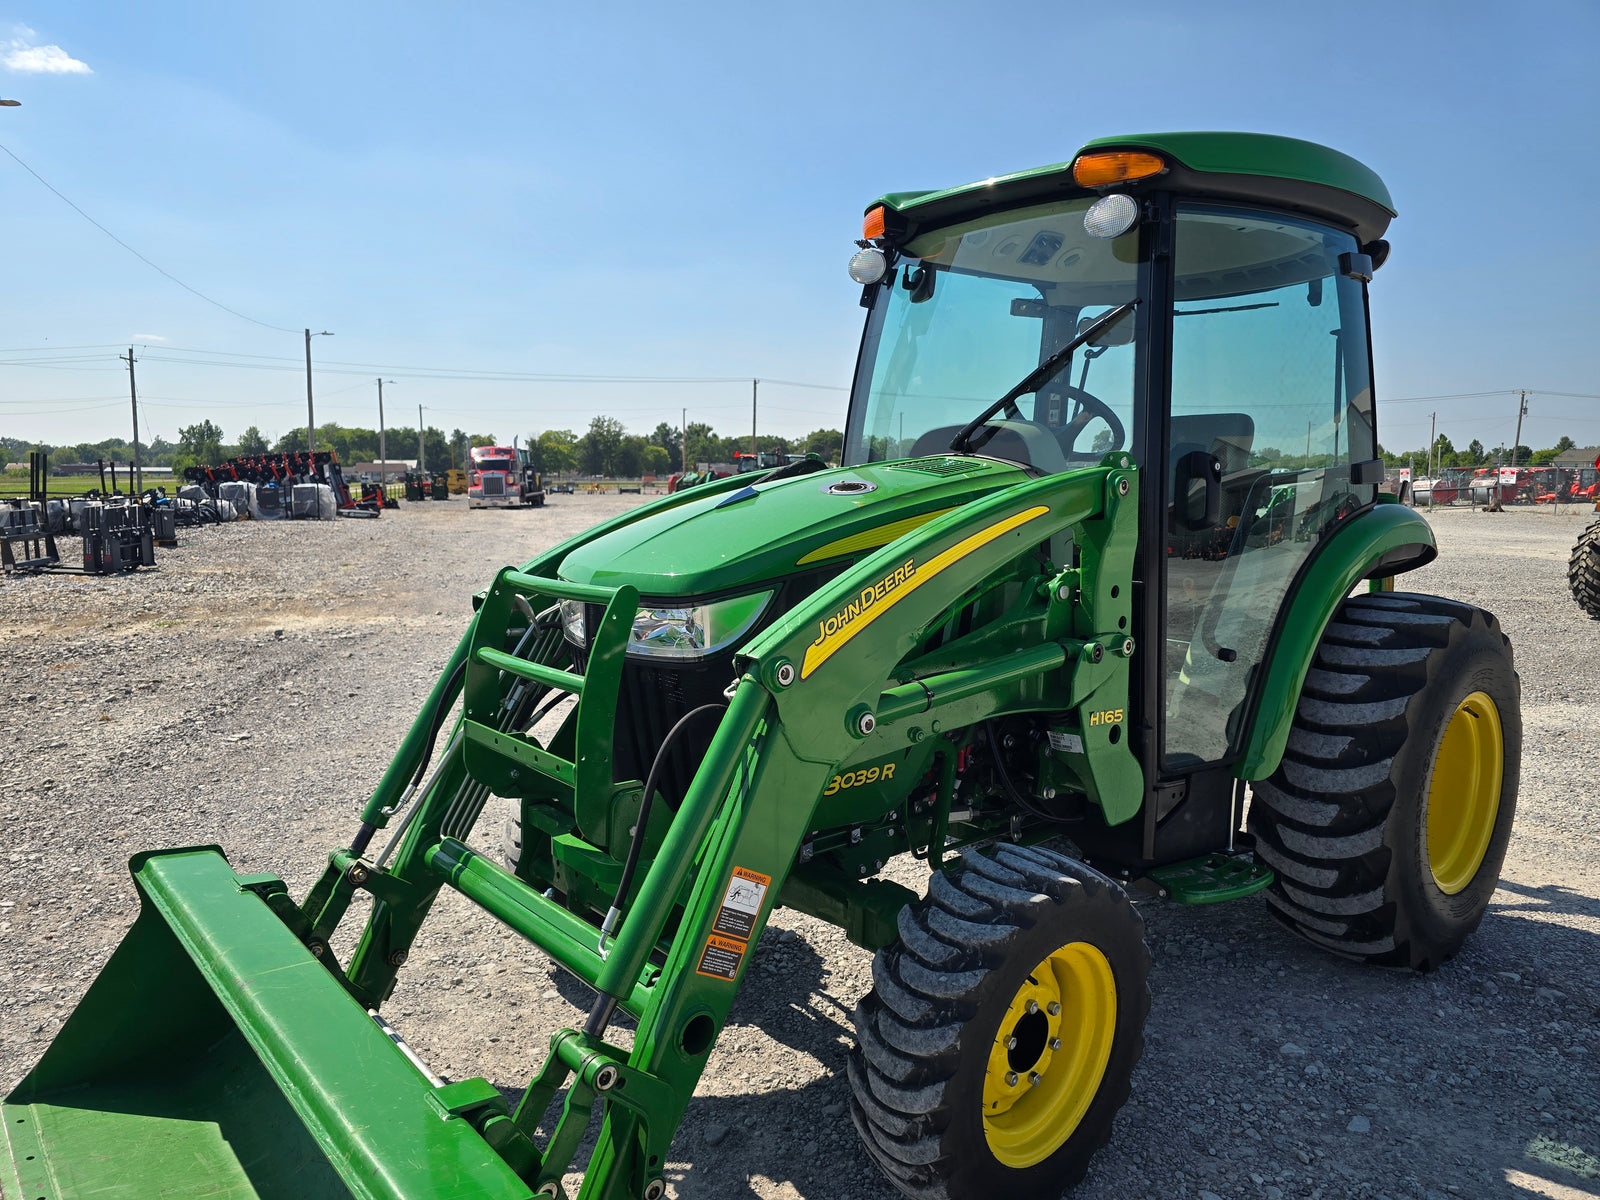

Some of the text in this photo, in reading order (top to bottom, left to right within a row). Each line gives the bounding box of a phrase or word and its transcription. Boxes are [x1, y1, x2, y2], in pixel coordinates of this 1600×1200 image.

[814, 558, 916, 646] JOHN DEERE
[1089, 708, 1124, 727] H165
[743, 870, 767, 883] WARNING
[718, 940, 743, 952] WARNING
